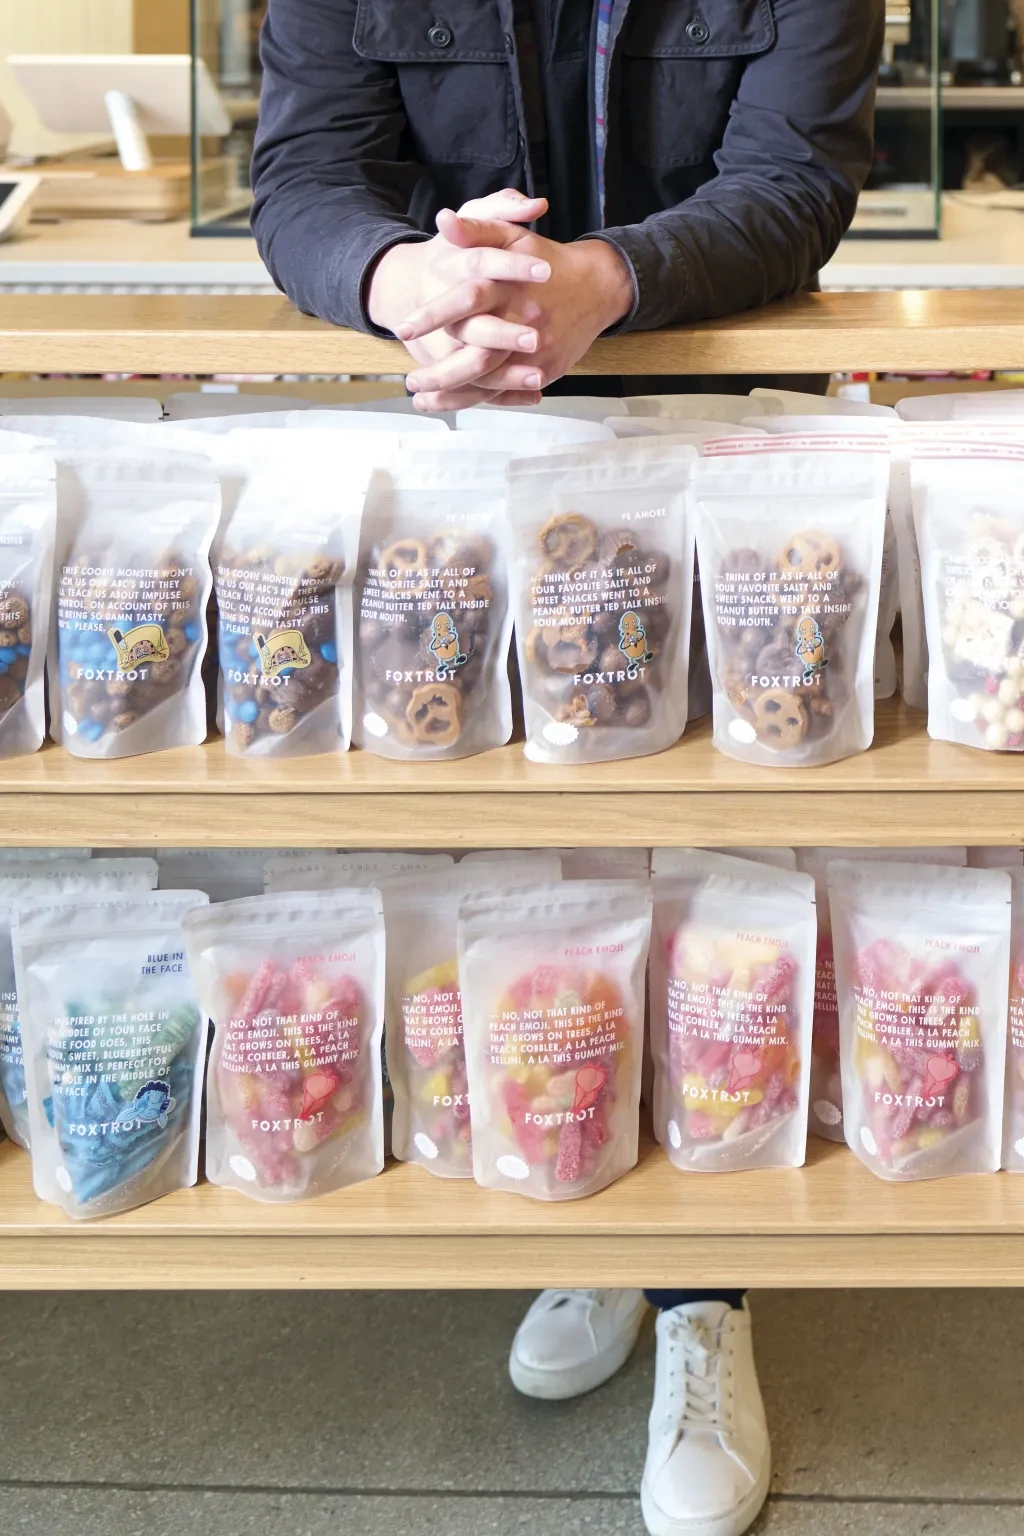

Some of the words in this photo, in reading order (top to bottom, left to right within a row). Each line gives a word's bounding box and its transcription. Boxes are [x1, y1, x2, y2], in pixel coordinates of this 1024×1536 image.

[635, 508, 667, 520] AMORE
[81, 567, 114, 576] COOKIE
[117, 568, 158, 578] MONSTER
[544, 572, 570, 583] THINK
[574, 572, 587, 581] OF
[601, 569, 613, 578] AS
[627, 566, 642, 576] ALL
[645, 564, 657, 573] OF
[140, 580, 155, 589] BUT
[159, 580, 180, 589] THEY
[531, 584, 555, 594] YOUR
[559, 582, 600, 593] FAVORITE
[604, 579, 629, 589] SALTY
[633, 576, 651, 585] AND
[68, 588, 91, 597] TEACH
[96, 589, 106, 598] US
[110, 590, 138, 599] ABOUT
[142, 591, 181, 600] IMPULSE
[532, 596, 558, 605] SWEET
[562, 593, 598, 604] SNACKS
[601, 590, 625, 600] WENT
[629, 589, 639, 597] TO
[91, 601, 104, 609] ON
[108, 601, 150, 611] ACCOUNT
[155, 601, 168, 610] OF
[533, 606, 566, 616] PEANUT
[570, 603, 600, 614] BUTTER
[604, 601, 619, 611] TED
[622, 598, 642, 609] TALK
[90, 611, 102, 620] SO
[105, 612, 133, 621] DAMN
[136, 613, 165, 622] TASTY.
[534, 618, 556, 627] YOUR
[75, 623, 106, 632] PLEASE.
[76, 668, 147, 681] FOXTROT
[228, 669, 291, 686] FOXTROT
[386, 669, 457, 682] FOXTROT
[573, 668, 646, 685] FOXTROT
[751, 674, 821, 688] FOXTROT
[736, 933, 762, 944] PEACH
[764, 936, 789, 948] EMOJI
[925, 939, 951, 950] PEACH
[565, 948, 592, 957] PEACH
[596, 944, 624, 954] EMOJI
[147, 953, 169, 964] BLUE
[172, 952, 183, 961] IN
[297, 955, 325, 963] PEACH
[329, 953, 356, 962] EMOJI
[142, 965, 157, 975] THE
[160, 964, 183, 973] FACE
[98, 1015, 107, 1024] BY
[112, 1014, 127, 1023] THE
[131, 1013, 155, 1022] HOLE
[158, 1012, 169, 1021] IN
[503, 1012, 520, 1021] NO,
[524, 1010, 543, 1019] NOT
[546, 1007, 567, 1018] THAT
[571, 1004, 592, 1014] KIND
[595, 1001, 606, 1010] OF
[490, 1022, 516, 1032] PEACH
[520, 1021, 550, 1031] EMOJI.
[554, 1019, 573, 1028] THIS
[588, 1013, 602, 1023] THE
[604, 1008, 624, 1019] KIND
[93, 1028, 105, 1036] OF
[110, 1025, 135, 1035] YOUR
[140, 1024, 162, 1033] FACE
[490, 1034, 509, 1043] THAT
[513, 1032, 544, 1042] GROWS
[547, 1031, 562, 1040] ON
[566, 1029, 593, 1039] TREES,
[606, 1022, 616, 1031] LA
[70, 1039, 96, 1049] FOOD
[100, 1037, 128, 1048] GOES,
[132, 1036, 151, 1045] THIS
[490, 1044, 517, 1053] PEACH
[520, 1043, 562, 1053] COBBLER,
[576, 1039, 587, 1048] LA
[590, 1034, 616, 1045] PEACH
[69, 1051, 99, 1061] SWEET,
[538, 1055, 550, 1063] LA
[553, 1053, 571, 1062] THIS
[575, 1047, 606, 1060] GUMMY
[73, 1063, 91, 1072] MIX
[107, 1060, 145, 1070] PERFECT
[148, 1057, 167, 1066] FOR
[86, 1074, 97, 1084] IN
[101, 1073, 116, 1082] THE
[120, 1069, 153, 1081] MIDDLE
[158, 1067, 171, 1076] OF
[682, 1084, 750, 1102] FOXTROT
[874, 1092, 945, 1107] FOXTROT
[251, 1111, 325, 1131] FOXTROT
[525, 1107, 596, 1125] FOXTROT
[69, 1119, 141, 1136] FOXTROT
